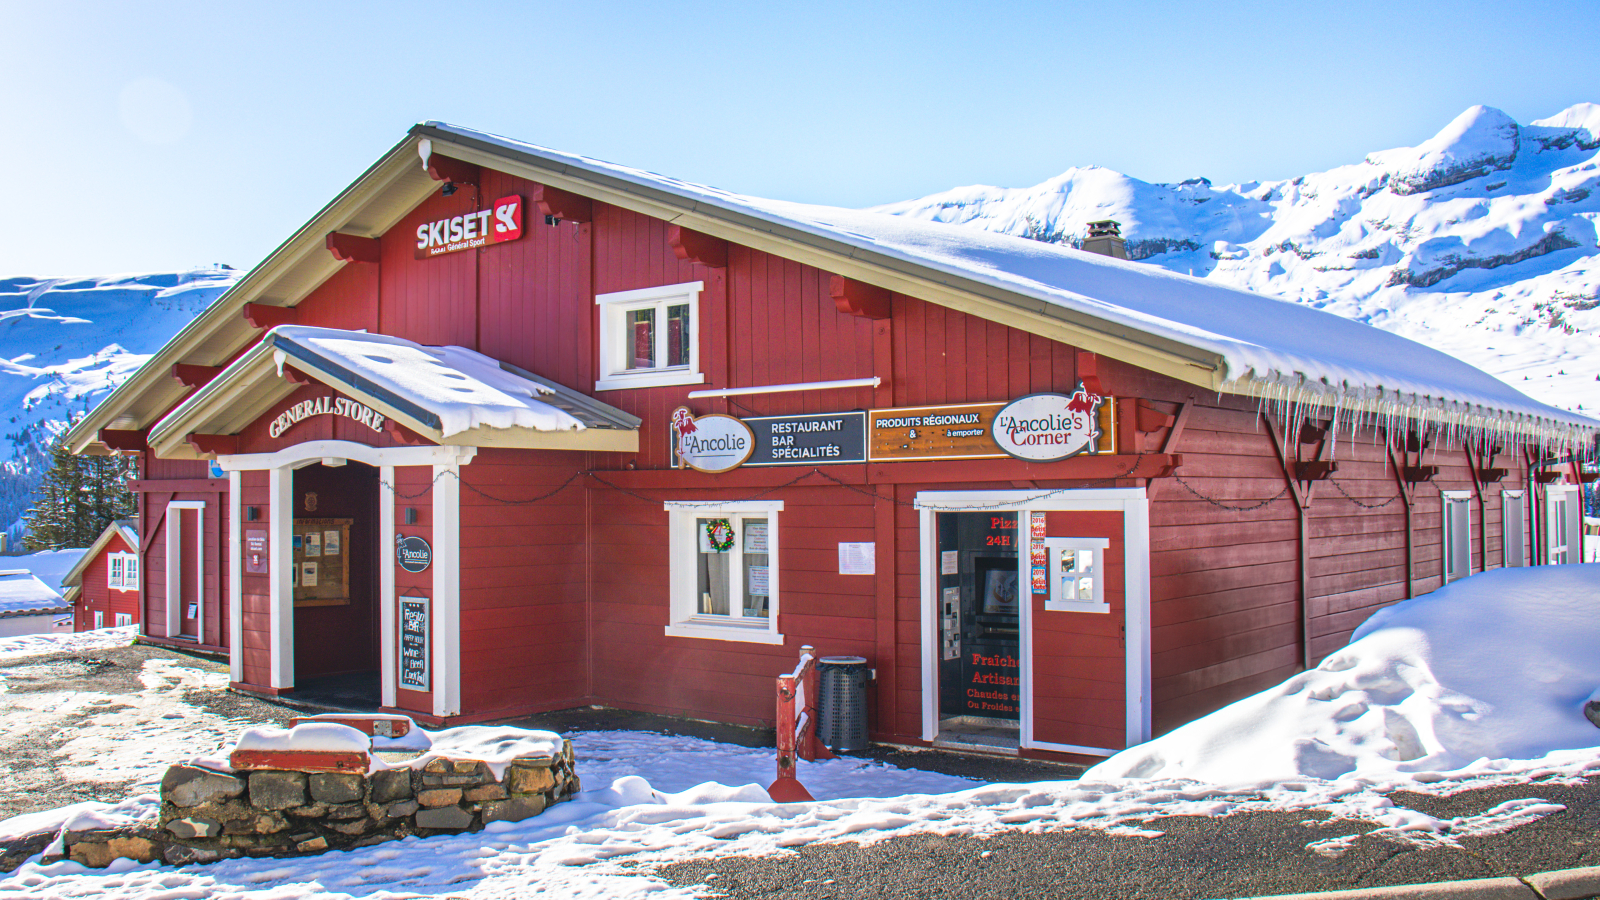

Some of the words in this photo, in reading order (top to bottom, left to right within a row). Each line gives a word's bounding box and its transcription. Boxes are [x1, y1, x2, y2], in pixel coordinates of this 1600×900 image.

[416, 209, 492, 249] SKISET
[447, 239, 469, 251] Général
[470, 237, 485, 248] Sport
[269, 396, 333, 438] GENERAL
[334, 397, 384, 433] STORE
[876, 417, 921, 429] PRODUITS
[922, 413, 980, 426] RÉGIONAUX
[1000, 413, 1083, 434] L'Ancolie's
[771, 419, 843, 434] RESTAURANT
[909, 429, 917, 439] &
[946, 429, 952, 437] à
[952, 428, 984, 438] emporter
[771, 435, 794, 447] BAR
[1010, 425, 1072, 446] Corner
[685, 433, 745, 453] L'Ancolie
[771, 445, 840, 459] SPÉCIALITÉS
[986, 535, 1010, 546] 24H
[402, 548, 428, 559] L'Ancolie
[966, 688, 1008, 700] Chaudes
[967, 700, 979, 709] Ou
